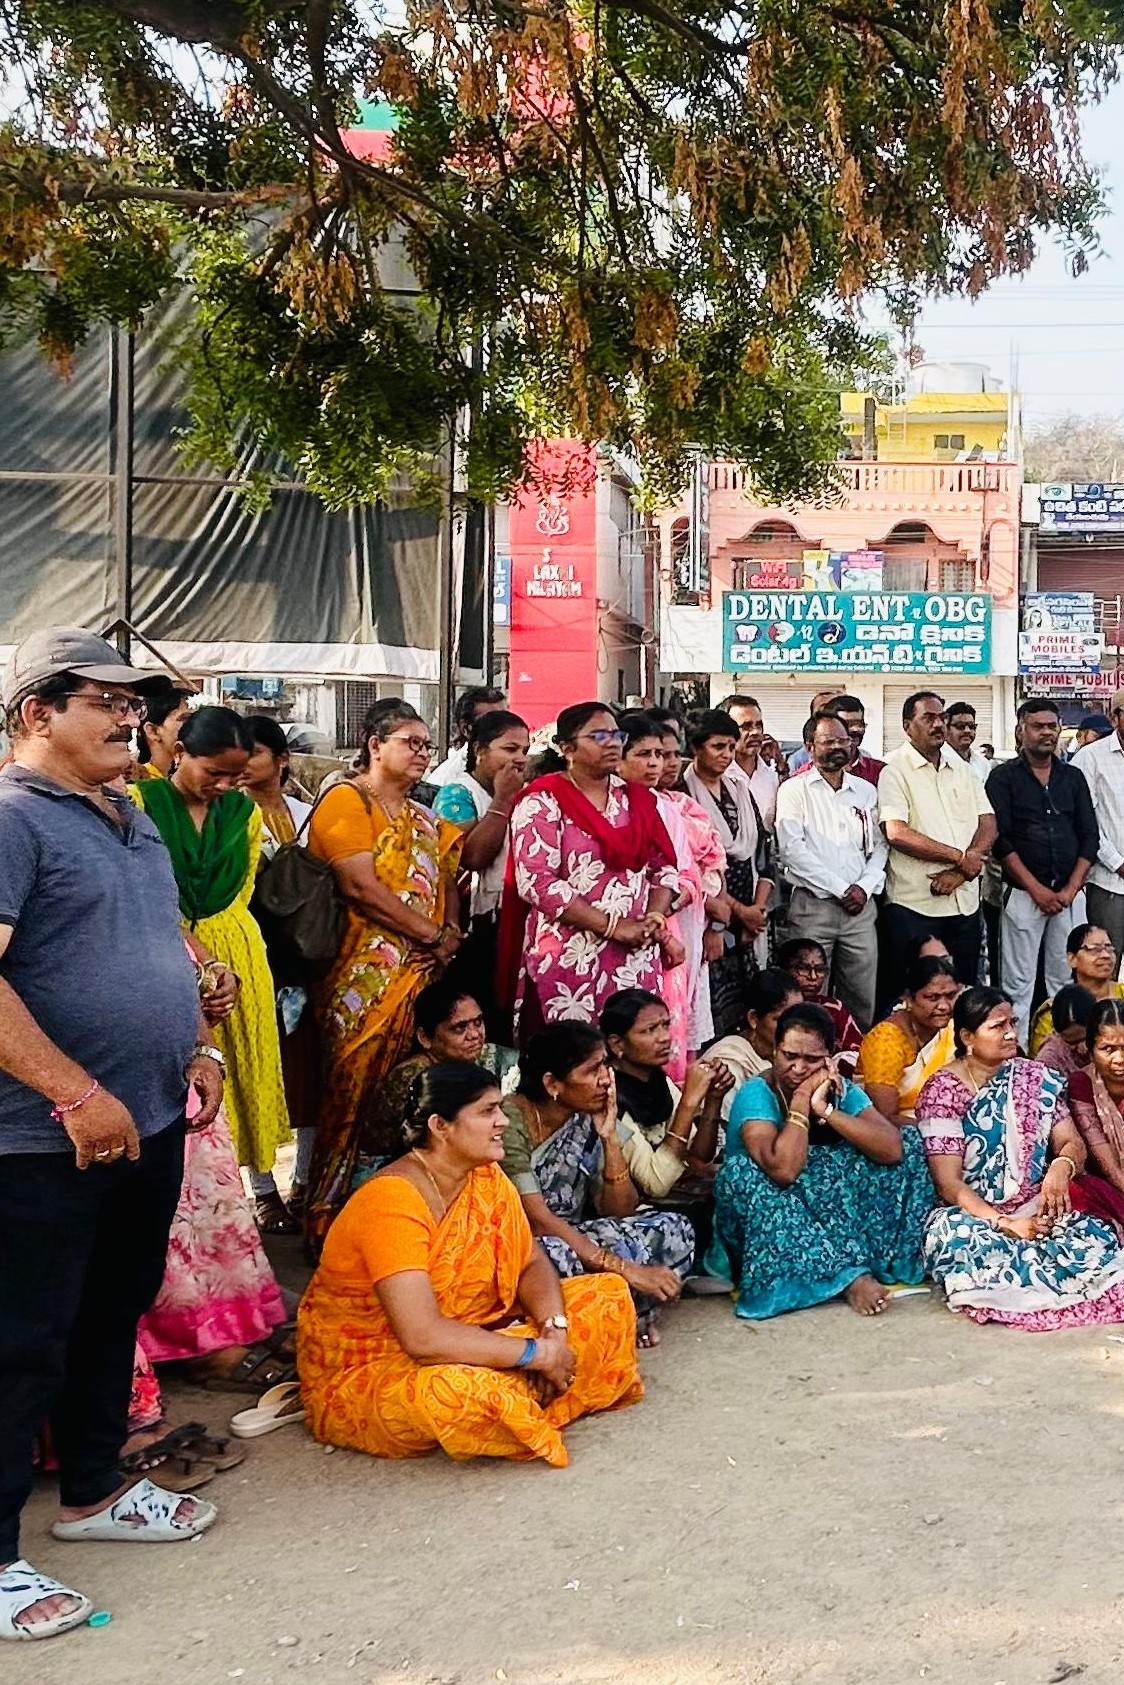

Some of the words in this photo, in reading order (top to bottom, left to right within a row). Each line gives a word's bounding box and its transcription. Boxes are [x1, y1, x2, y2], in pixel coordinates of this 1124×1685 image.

[533, 564, 575, 580] LAXI
[728, 594, 843, 621] DENTAL
[852, 595, 911, 621] ENT
[924, 596, 987, 622] OBG
[1038, 635, 1077, 644] PRIME
[730, 643, 812, 664] డెంటల్
[1031, 645, 1085, 654] MOBILES
[1035, 673, 1073, 686] PRIME
